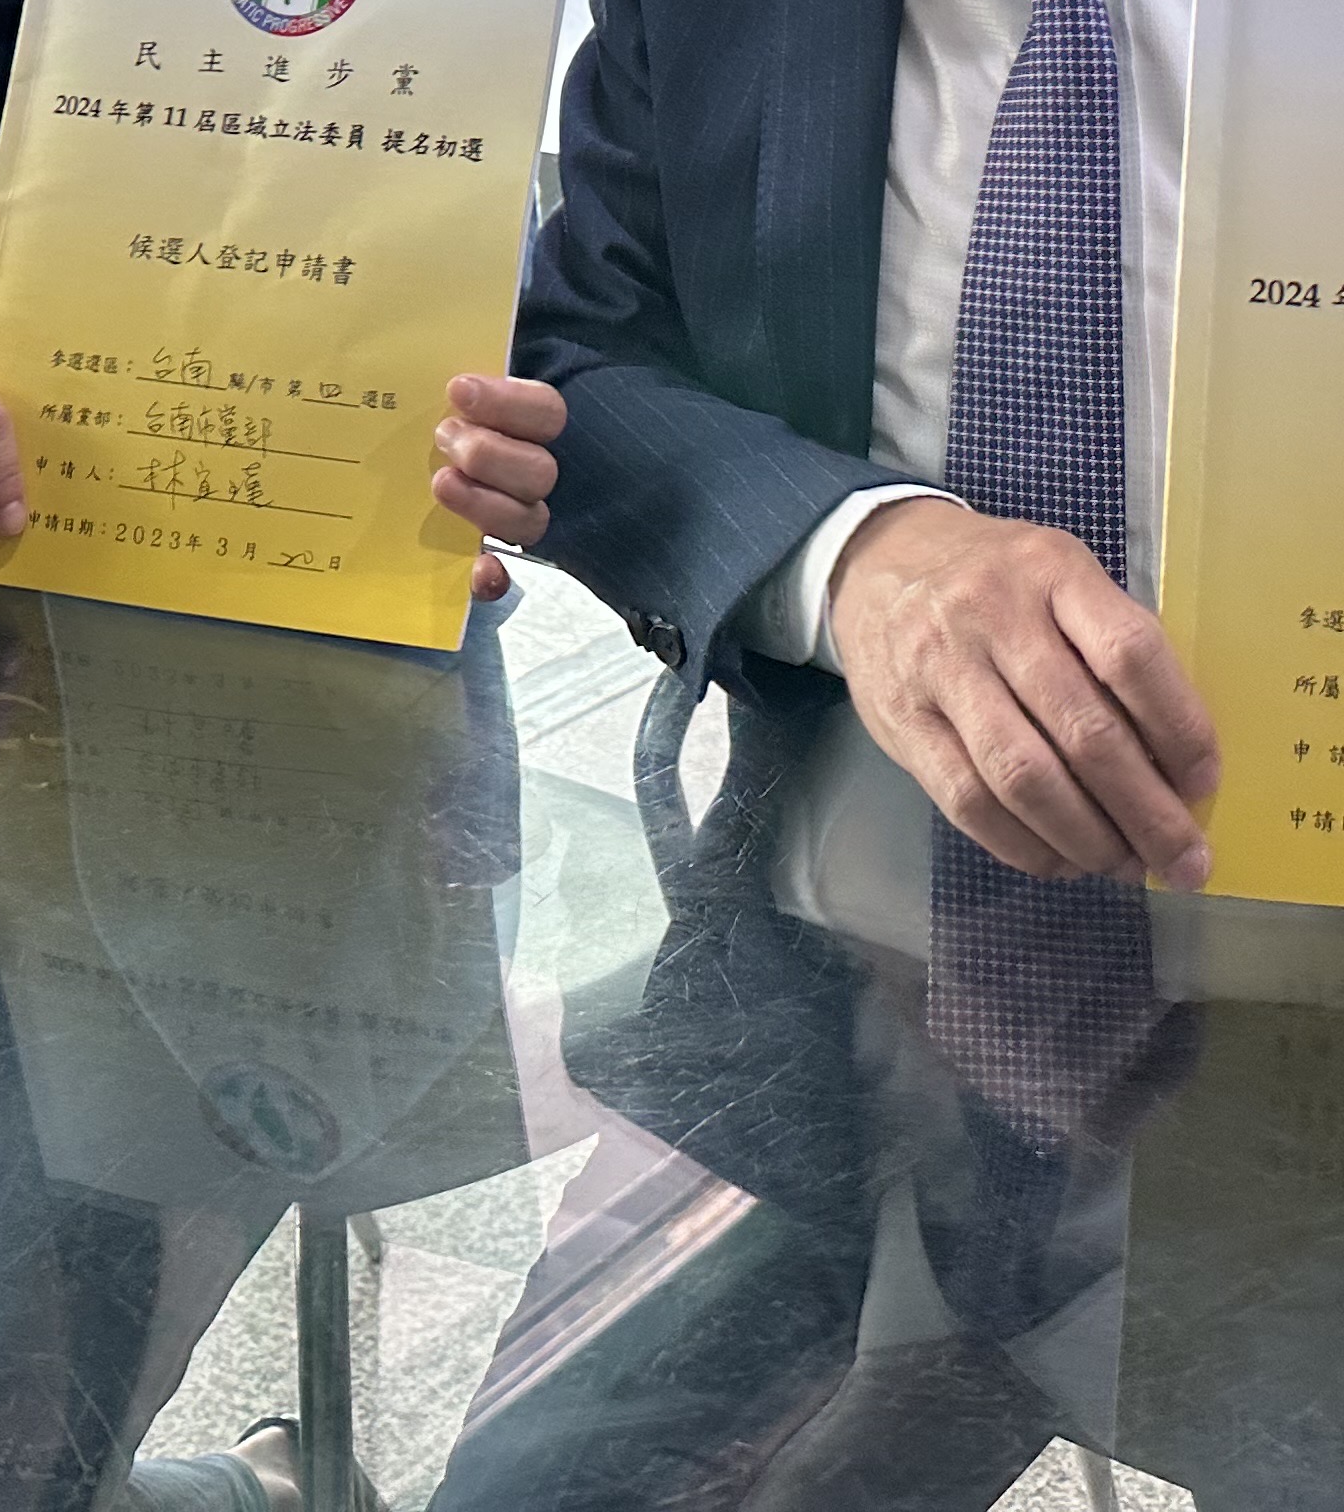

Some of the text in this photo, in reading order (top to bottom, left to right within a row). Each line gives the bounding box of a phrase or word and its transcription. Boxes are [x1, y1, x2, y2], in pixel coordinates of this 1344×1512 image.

[134, 41, 420, 96] 民主進步黨
[128, 233, 358, 286] 候選人登記申請書
